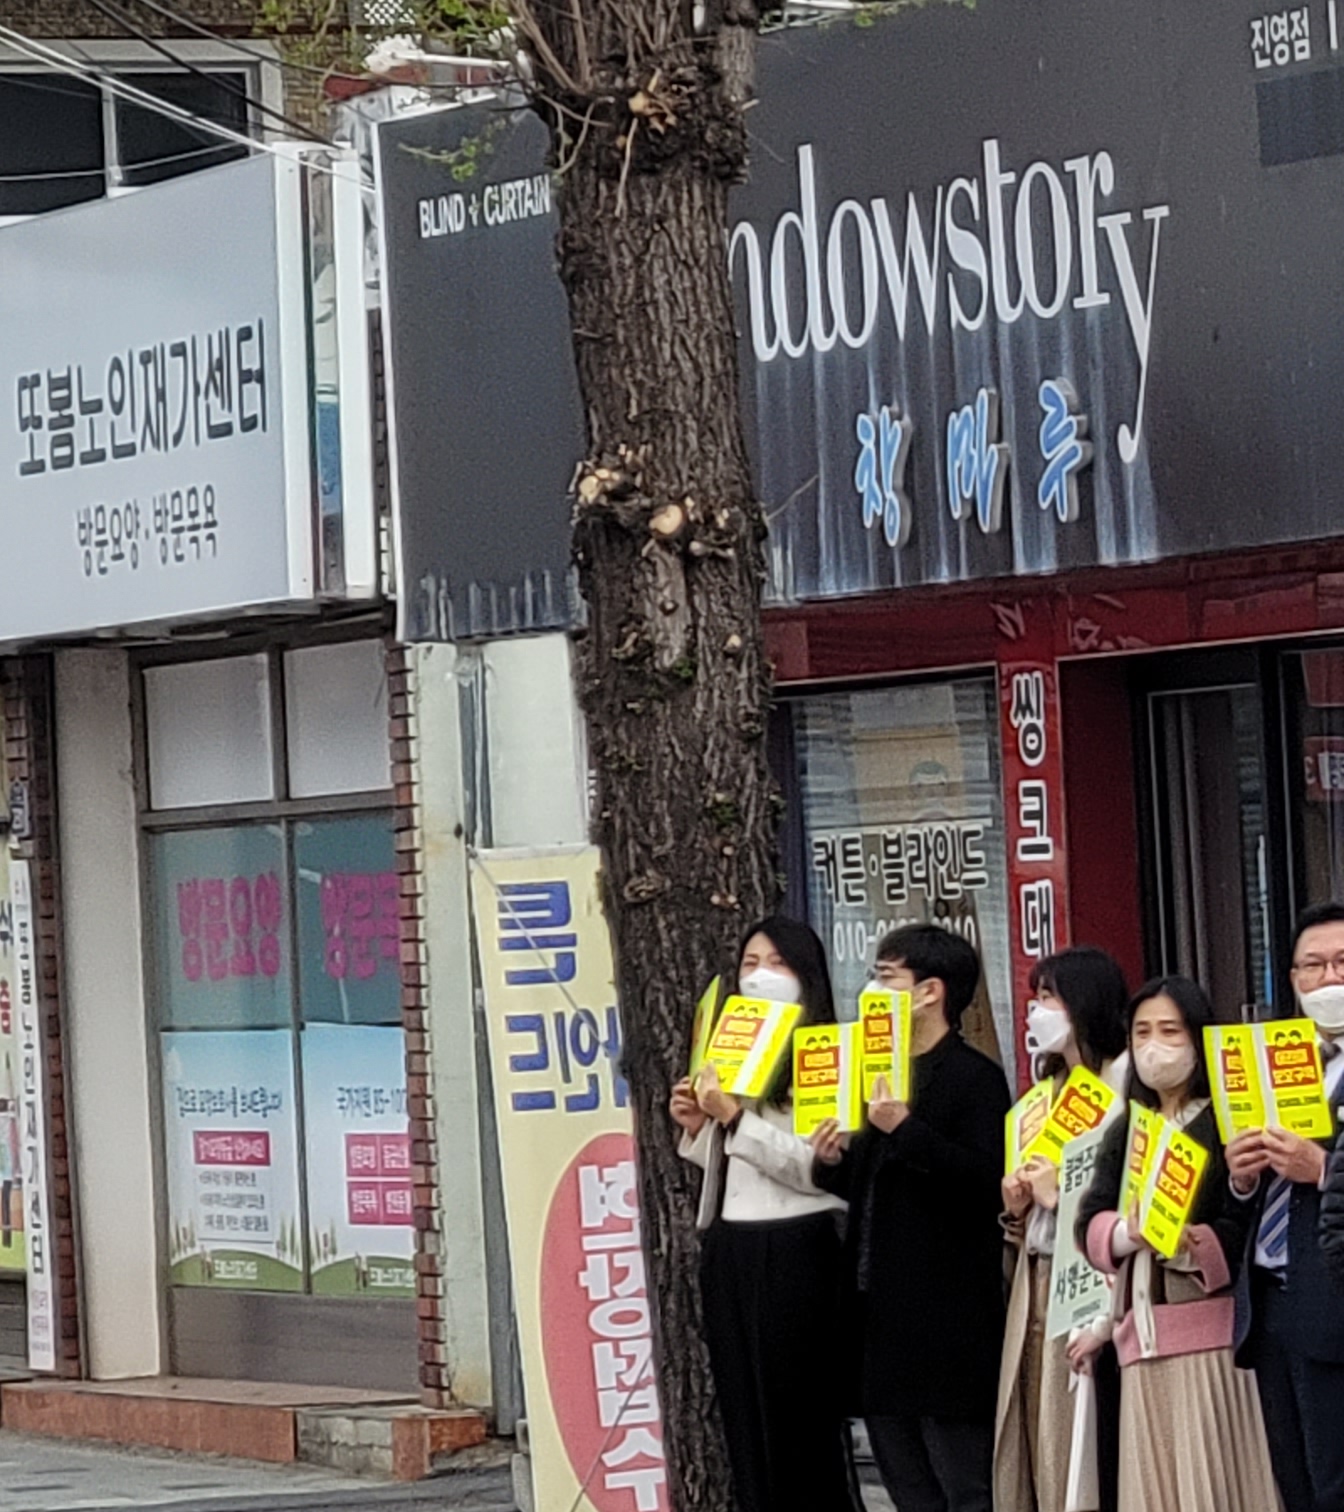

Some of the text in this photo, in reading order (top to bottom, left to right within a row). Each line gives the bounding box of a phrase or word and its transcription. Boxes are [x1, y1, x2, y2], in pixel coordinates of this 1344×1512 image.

[1250, 7, 1311, 69] 진영점
[418, 193, 466, 239] BLIND
[483, 173, 551, 227] CURTAIN
[17, 316, 267, 477] 또봄노인재가센터
[1011, 670, 1058, 1095] 씽크대
